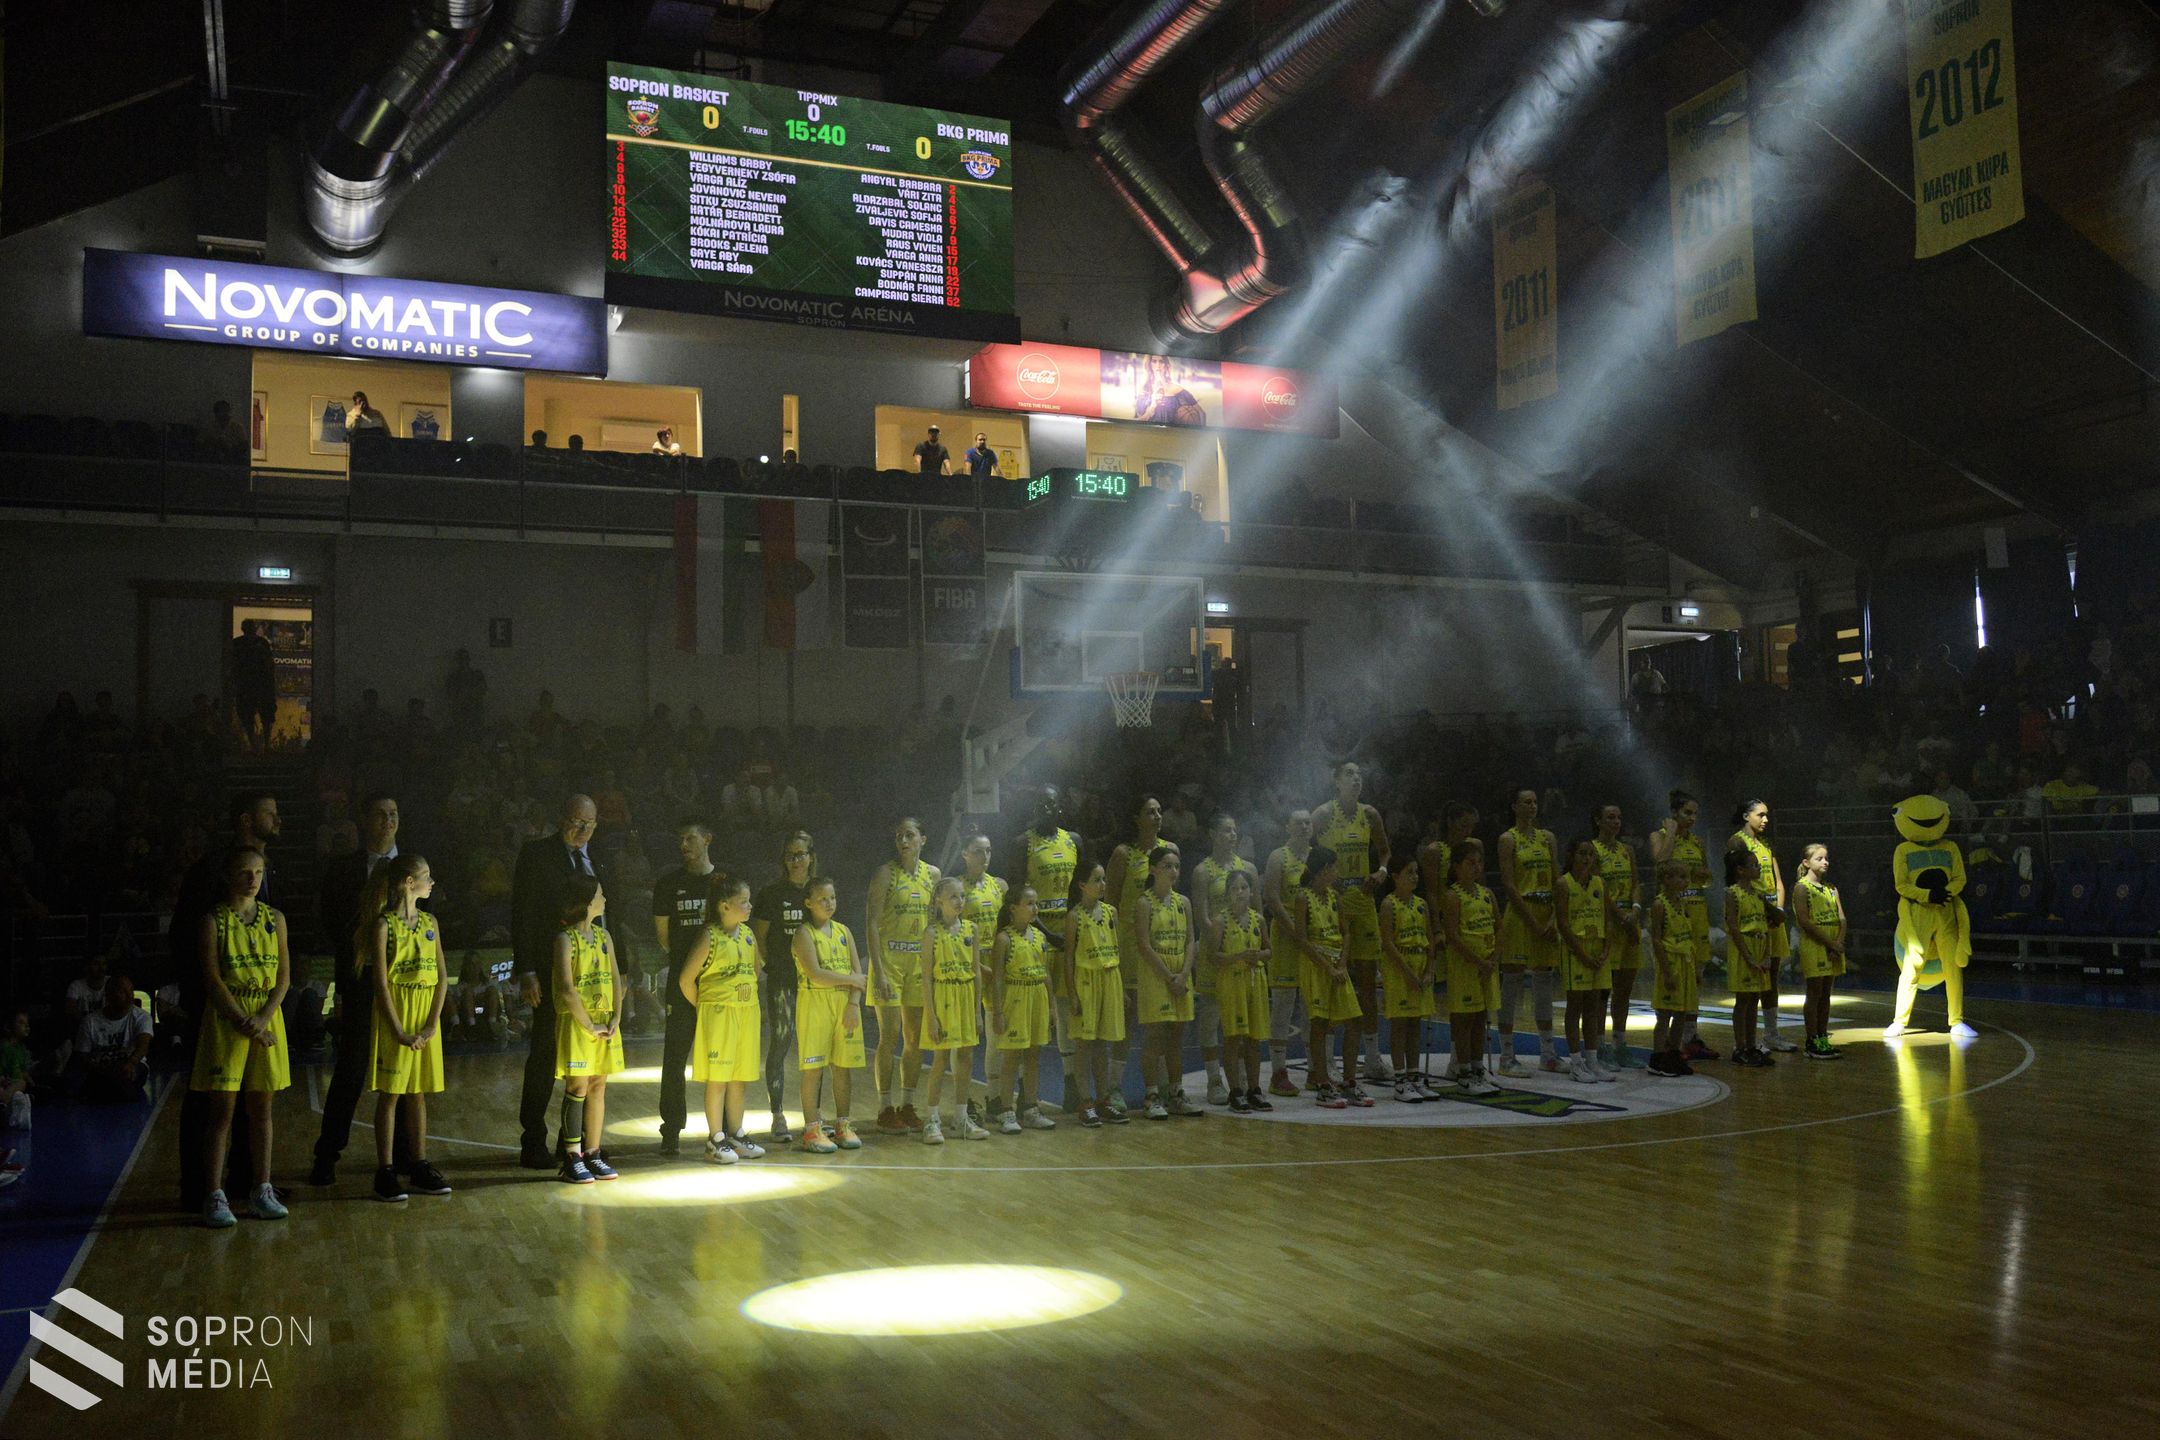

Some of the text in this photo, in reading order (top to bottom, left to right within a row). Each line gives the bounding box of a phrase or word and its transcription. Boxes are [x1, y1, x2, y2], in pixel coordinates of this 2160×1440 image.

[609, 76, 729, 105] SOPRON BASKET
[1916, 38, 2004, 140] 2012
[797, 90, 838, 106] TIPPMIX
[703, 106, 719, 129] 0
[808, 104, 820, 122] 0
[785, 119, 846, 146] 15:40
[937, 123, 1009, 146] BKG PRIMA
[616, 140, 625, 152] 3
[916, 136, 932, 160] 0
[616, 152, 625, 162] 4
[689, 151, 773, 171] WILLIAMS GABBY
[616, 173, 625, 184] 9
[689, 161, 796, 185] FEGYVERNEKY ZSÓFIA
[690, 172, 747, 189] VARGA ALÍZ
[1923, 151, 2009, 204] MAGYAR KUPA
[613, 184, 626, 195] 10
[861, 173, 942, 193] ANGYAL BARBARA
[948, 184, 956, 195] 2
[612, 195, 626, 206] 14
[689, 183, 787, 204] JOVANOVIC NEVENA
[852, 193, 905, 209] ALDAZABAL
[897, 188, 942, 203] VÁRI ZITA
[948, 195, 956, 205] 4
[612, 206, 626, 217] 16
[690, 194, 779, 214] SITKU ZSUZSANNA
[690, 205, 782, 225] HATÁR BERNADETT
[856, 204, 943, 223] ZIVALJEVIC SOFIJA
[612, 217, 627, 228] 22
[690, 215, 784, 236] MOLNÁROVA LAURA
[869, 216, 943, 233] DAVIS CAMESHA
[949, 225, 957, 235] 7
[612, 227, 627, 239] 32
[690, 226, 767, 244] KÓKAI PATRÍCIA
[881, 228, 943, 244] MUDRA VIOLA
[949, 235, 957, 246] 9
[612, 238, 627, 250] 33
[690, 237, 769, 255] BROOKS JELENA
[886, 239, 943, 254] RAUS VIVIEN
[946, 245, 958, 255] 15
[612, 250, 627, 262] 44
[690, 248, 739, 262] GAYE ABY
[885, 248, 943, 264] VARGA ANNA
[946, 255, 958, 265] 17
[690, 259, 753, 274] VARGA SÁRA
[856, 255, 944, 274] KOVÁCS VANESSZA
[880, 268, 944, 285] SUPPÁN ANNA
[946, 275, 960, 287] 22
[878, 279, 944, 295] BODNÁR FANNI
[946, 286, 960, 297] 37
[855, 287, 944, 305] CAMPISANO SIERRA
[1503, 266, 1549, 332] 2011
[164, 268, 534, 347] NOVOMATIC
[724, 289, 916, 325] NOVOMATIC ARÉNA
[797, 317, 846, 328] SOPRON
[224, 324, 479, 358] GROUP OF COMPANIES
[1020, 368, 1057, 385] Coca-Cola
[1264, 391, 1297, 406] Coca-Cola
[1027, 475, 1050, 501] 15:40
[1075, 473, 1126, 495] 15:40
[934, 587, 976, 608] FIBA
[735, 983, 752, 1002] 10
